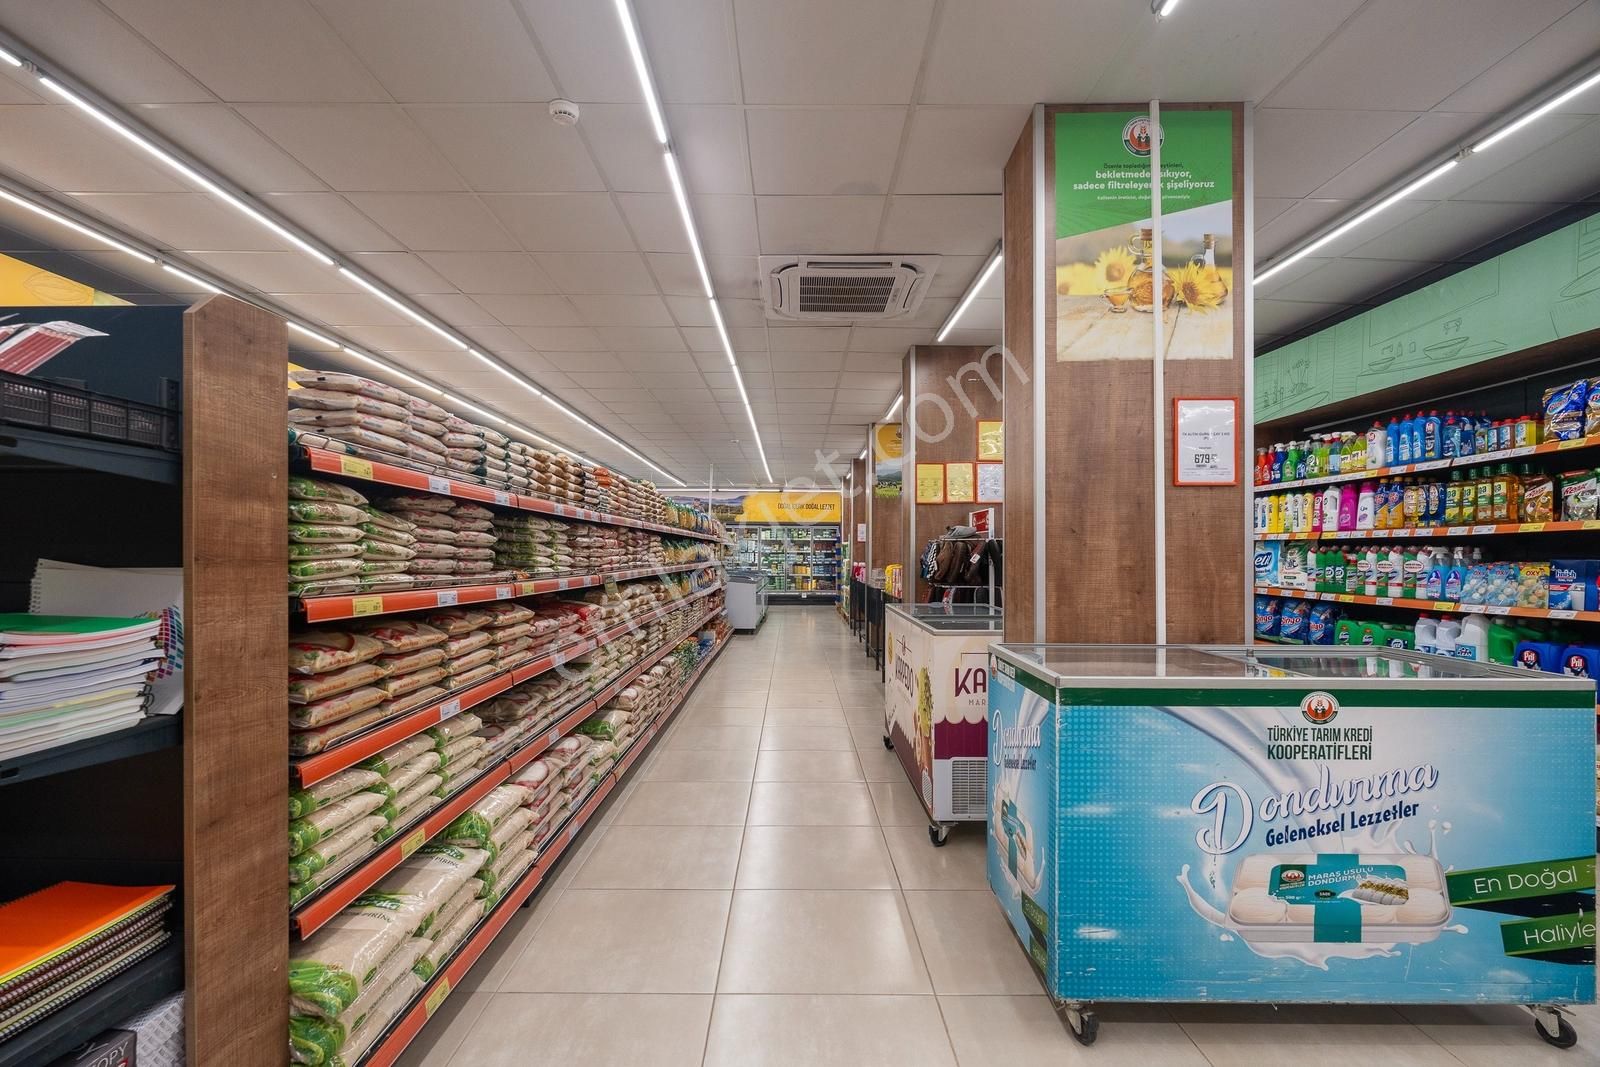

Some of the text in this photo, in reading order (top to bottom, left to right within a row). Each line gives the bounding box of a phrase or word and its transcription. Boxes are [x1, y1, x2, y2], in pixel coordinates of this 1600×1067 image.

[1095, 170, 1152, 180] bekletmede
[1072, 181, 1106, 191] sadece
[1166, 179, 1215, 190] şişeliyoruz
[1194, 453, 1210, 464] 679
[1523, 650, 1535, 662] Pril
[1570, 656, 1583, 668] Pril
[954, 667, 987, 698] KA
[1267, 725, 1373, 742] TÜRKİYE TARIM KREDİ
[1267, 742, 1372, 760] KOOPERATİFLERİ
[1190, 763, 1439, 856] Dondurma
[1265, 801, 1419, 848] Geleneksel Lezzetler
[1308, 873, 1362, 887] DONDURMA
[1474, 865, 1578, 894] En Doğal
[1523, 921, 1596, 945] Haliyle
[91, 1041, 128, 1067] OPY
